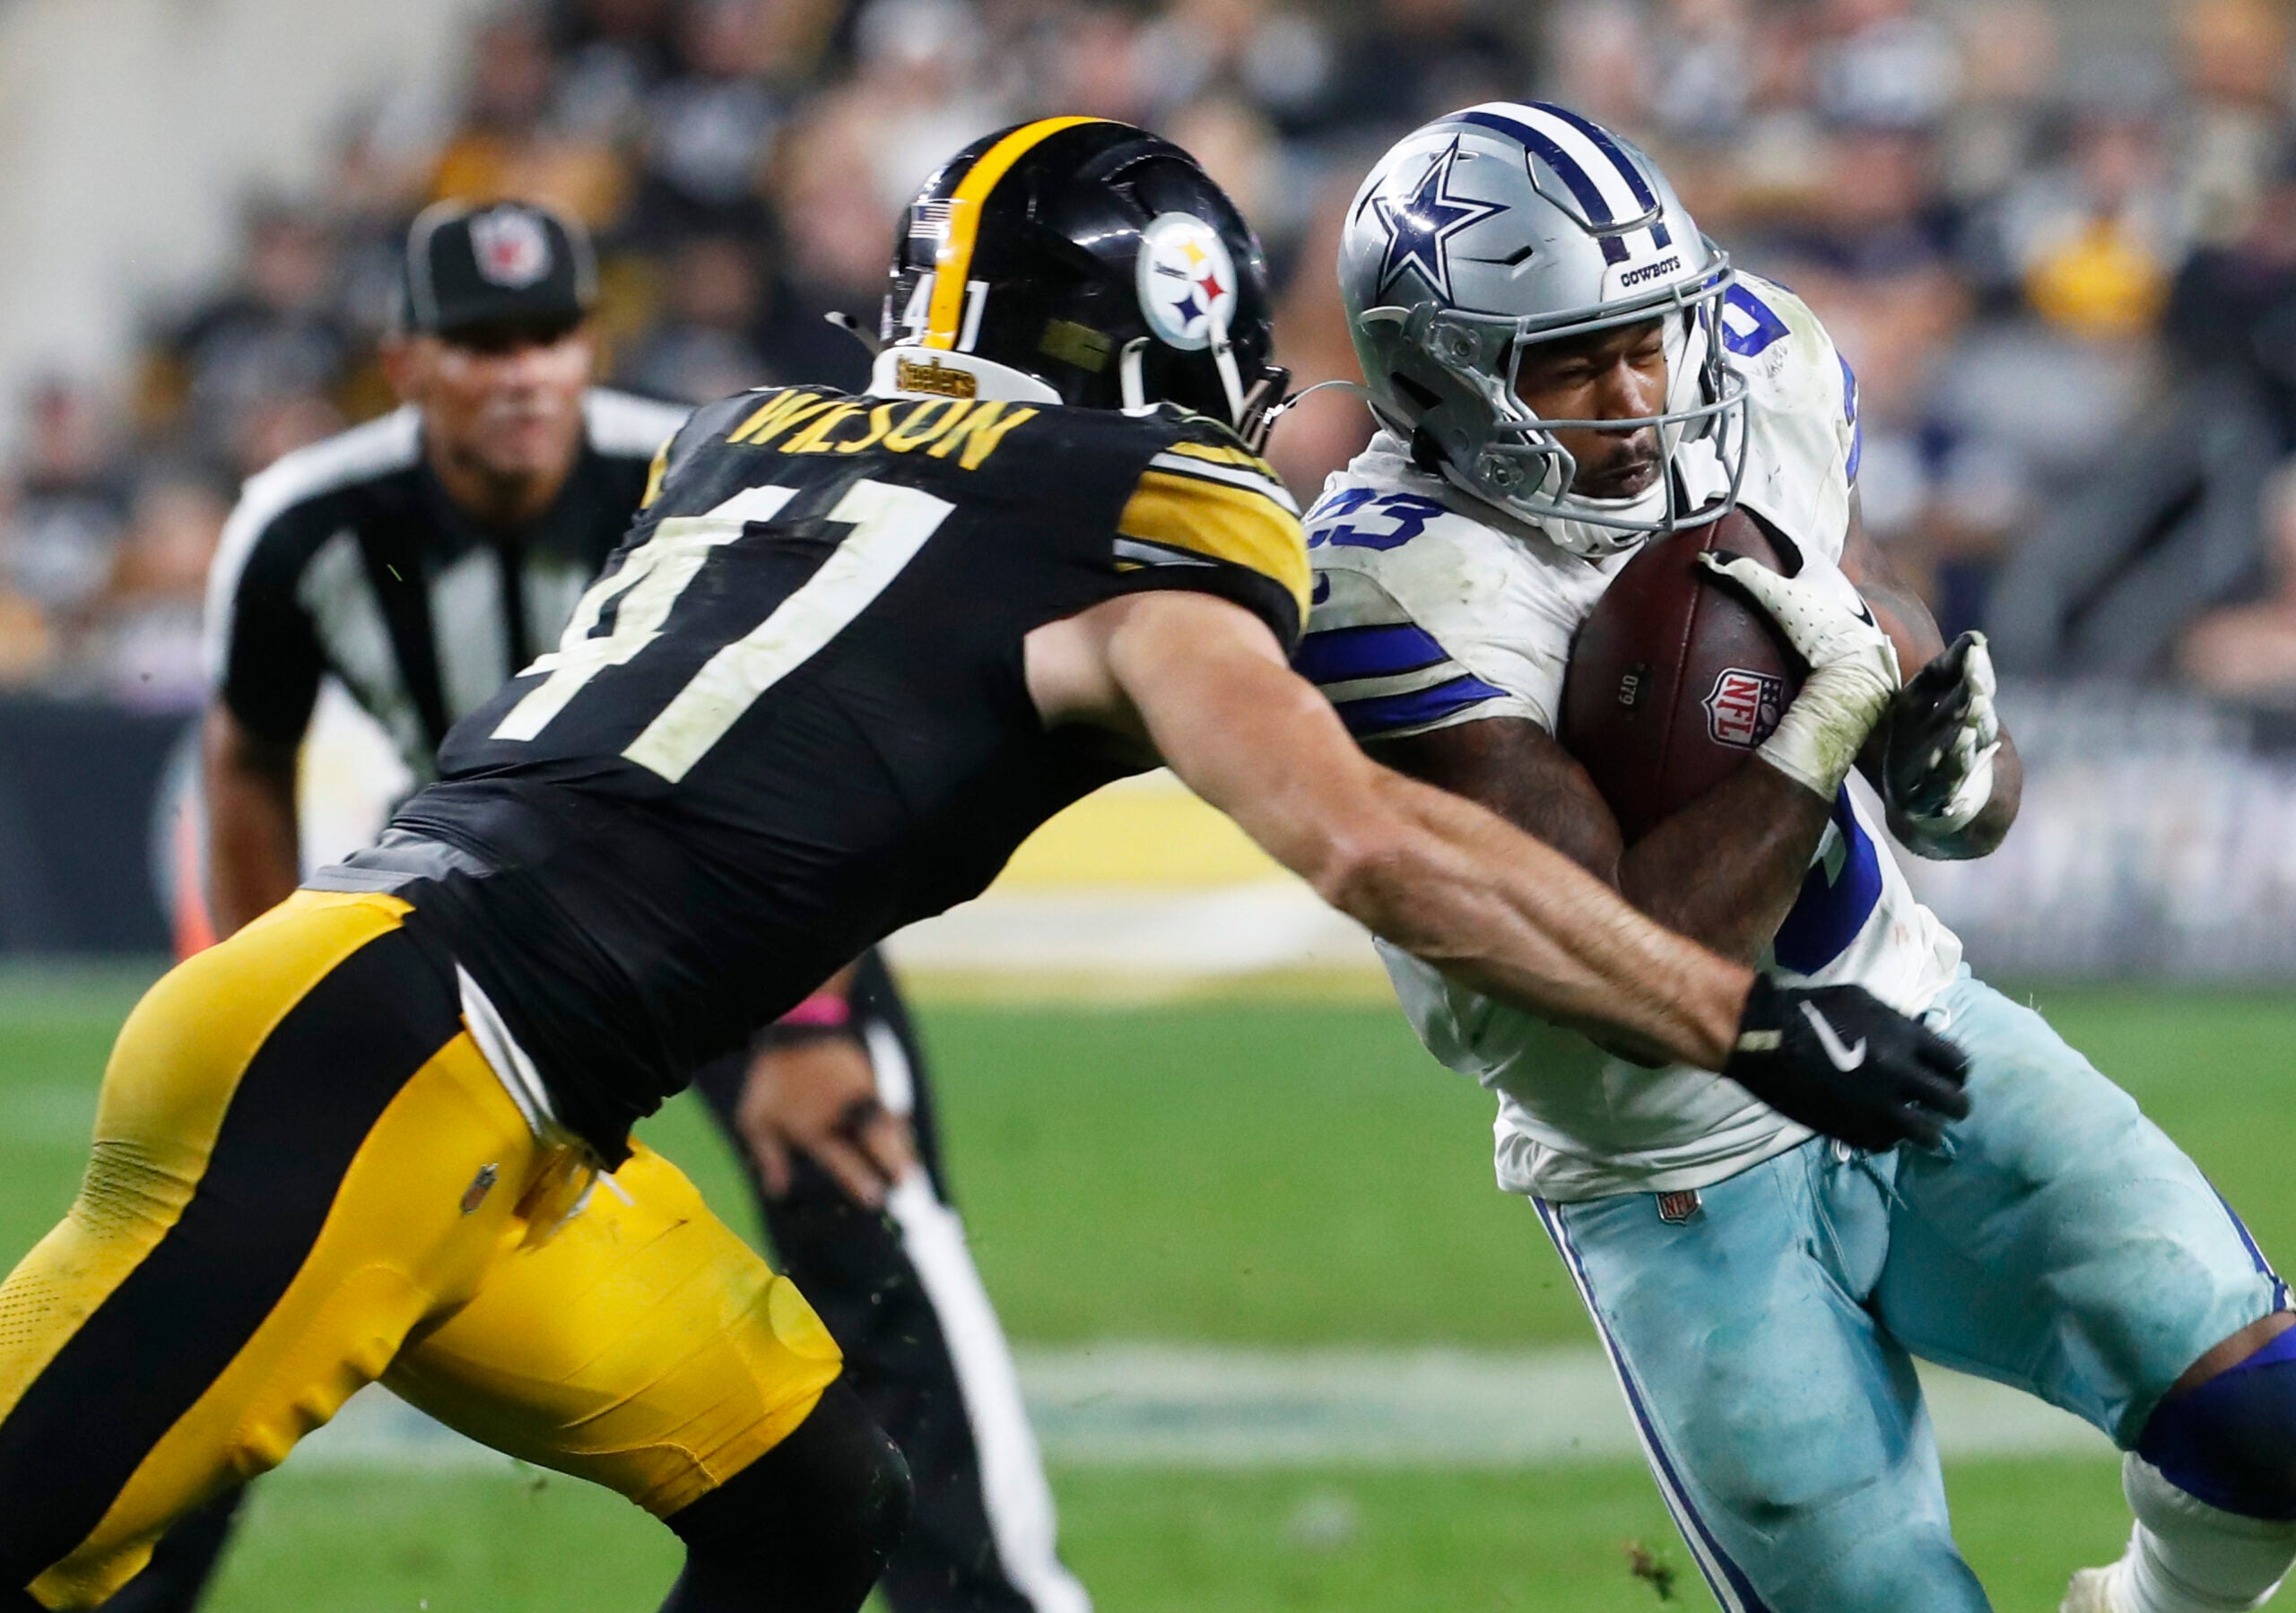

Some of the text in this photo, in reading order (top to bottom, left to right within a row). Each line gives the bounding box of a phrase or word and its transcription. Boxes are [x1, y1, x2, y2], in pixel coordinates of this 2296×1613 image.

[1620, 255, 1682, 287] COWBOYS
[901, 273, 990, 353] 41
[726, 389, 1040, 471] WILSON
[1618, 674, 1639, 706] 079
[1715, 677, 1760, 737] NFL
[1664, 1193, 1696, 1216] NFL
